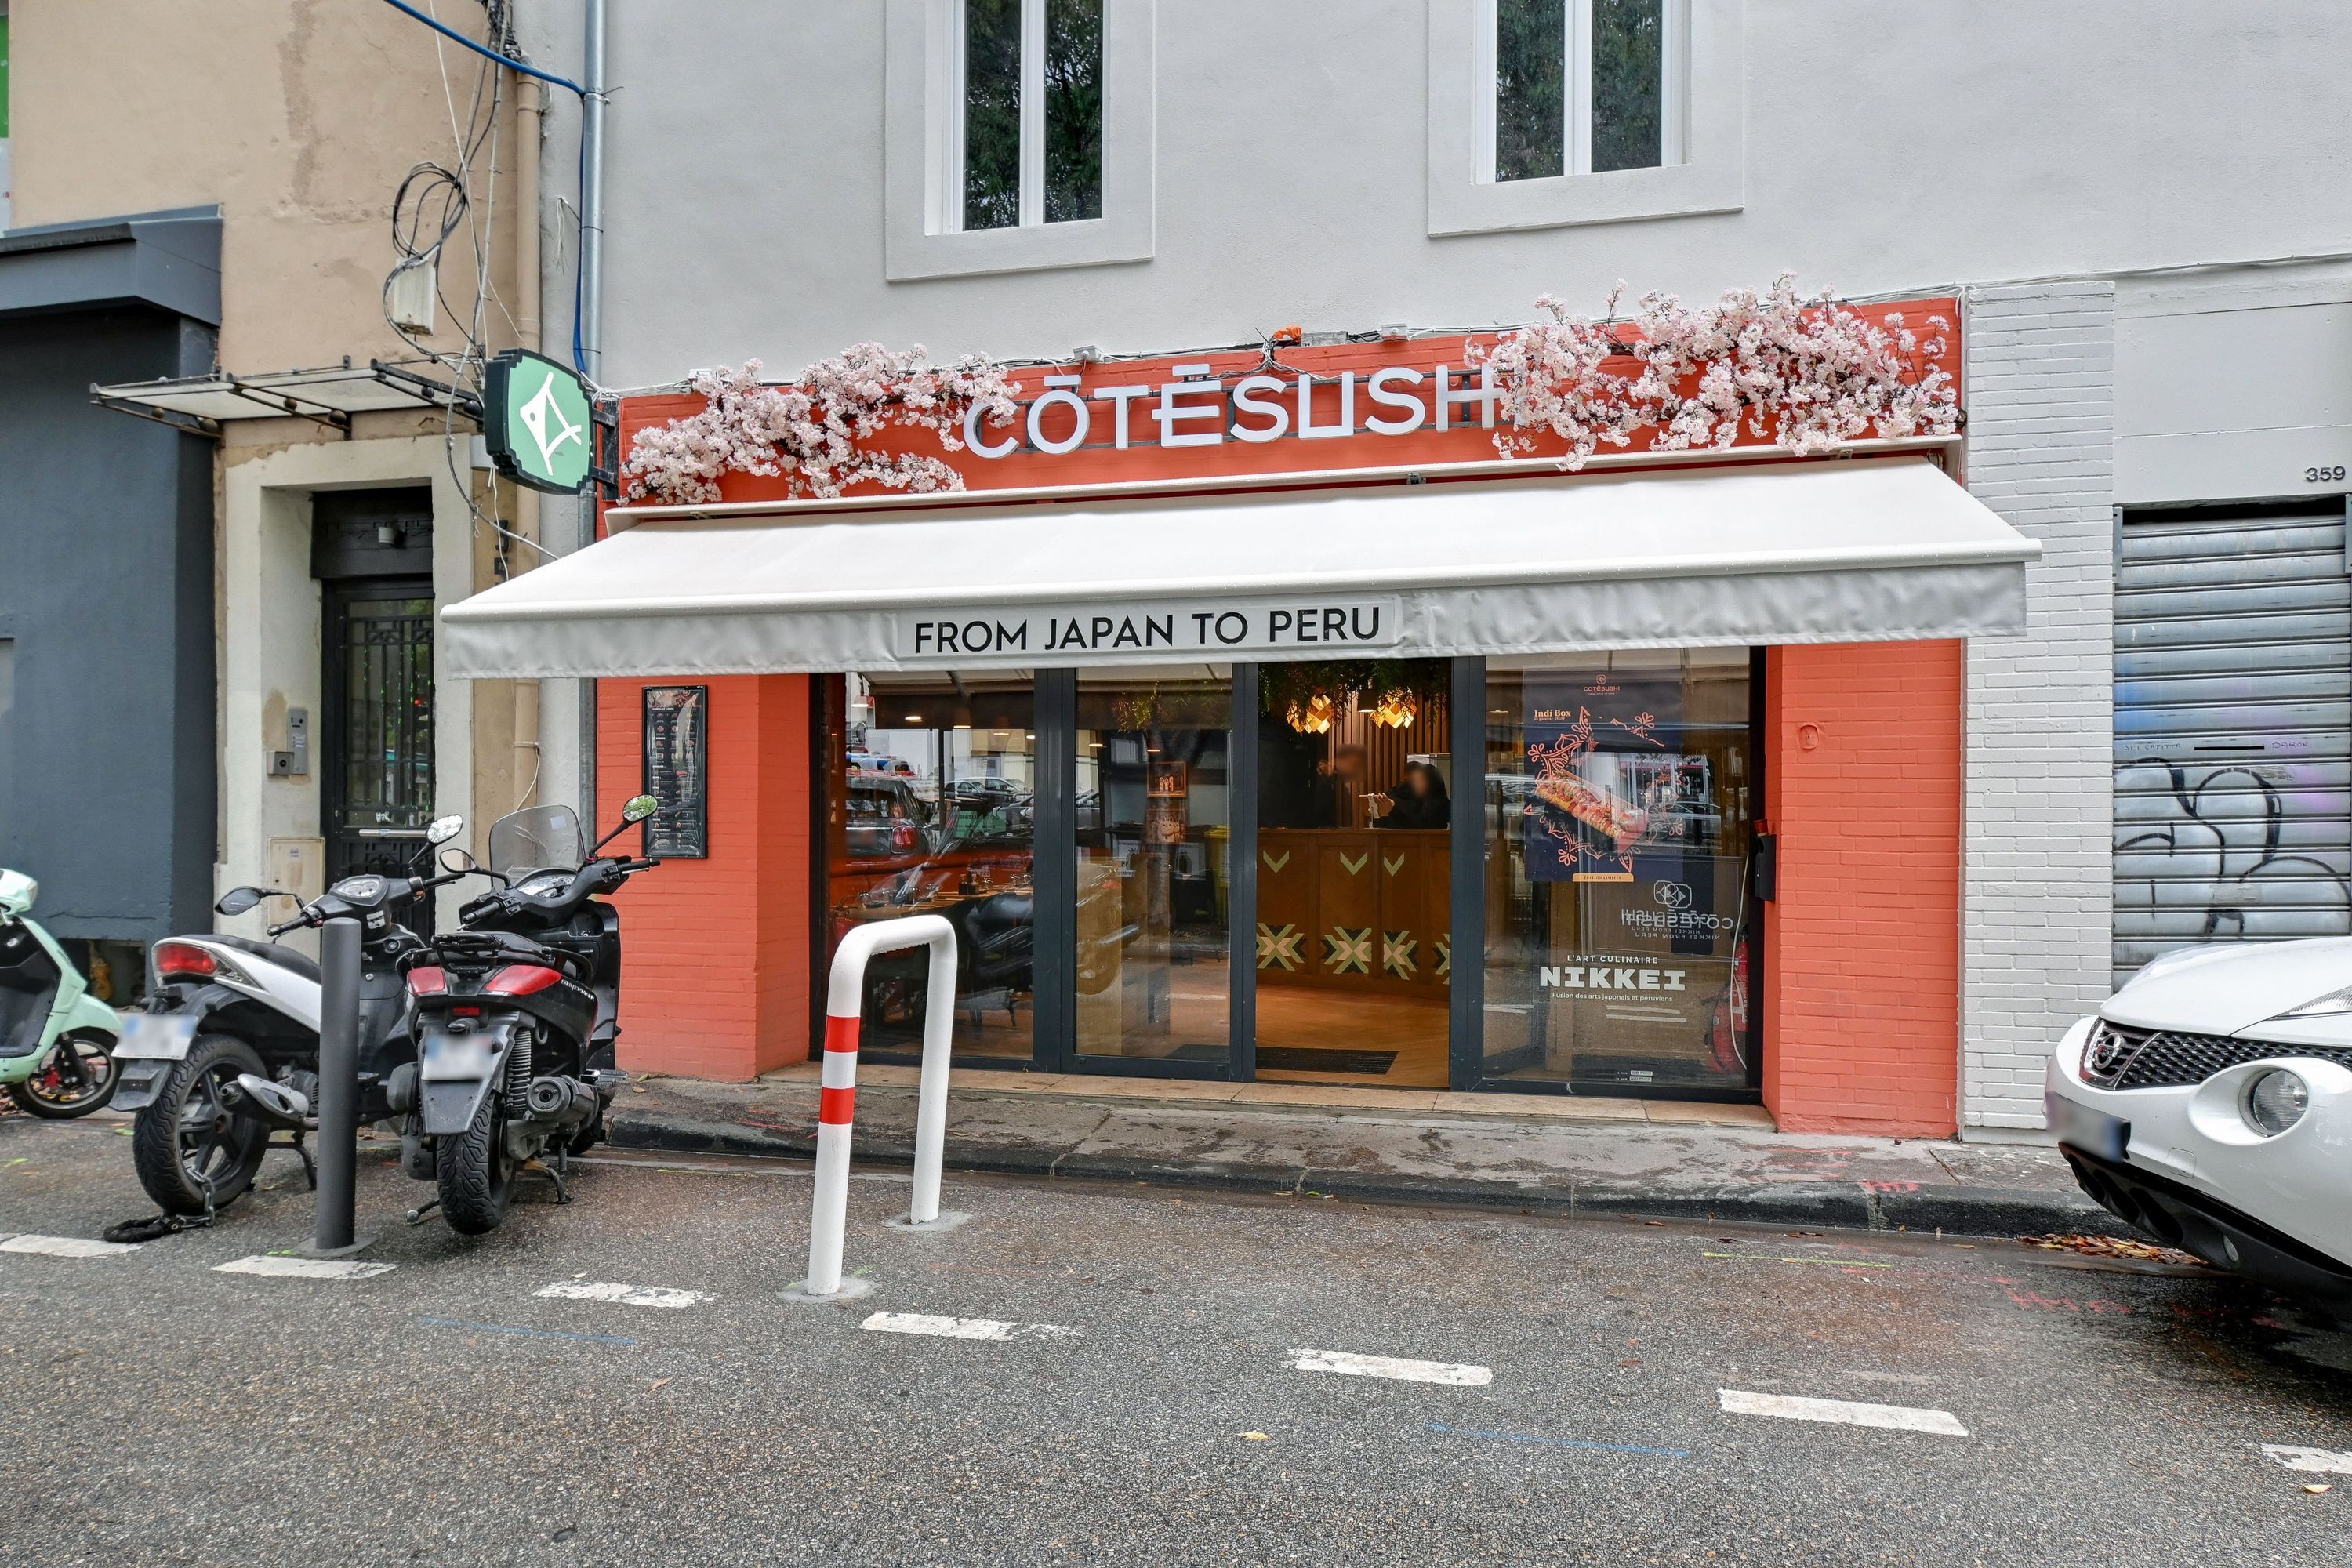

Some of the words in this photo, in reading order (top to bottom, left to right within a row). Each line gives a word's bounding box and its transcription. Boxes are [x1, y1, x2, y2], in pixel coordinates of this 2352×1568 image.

[2305, 466, 2346, 482] 359
[915, 618, 1028, 654] FROM
[1044, 614, 1174, 650] JAPAN
[1192, 612, 1248, 644] TO
[1269, 607, 1380, 643] PERU
[1534, 709, 1552, 717] Indi
[1554, 709, 1571, 717] Box
[1540, 966, 1686, 991] NIKKEI
